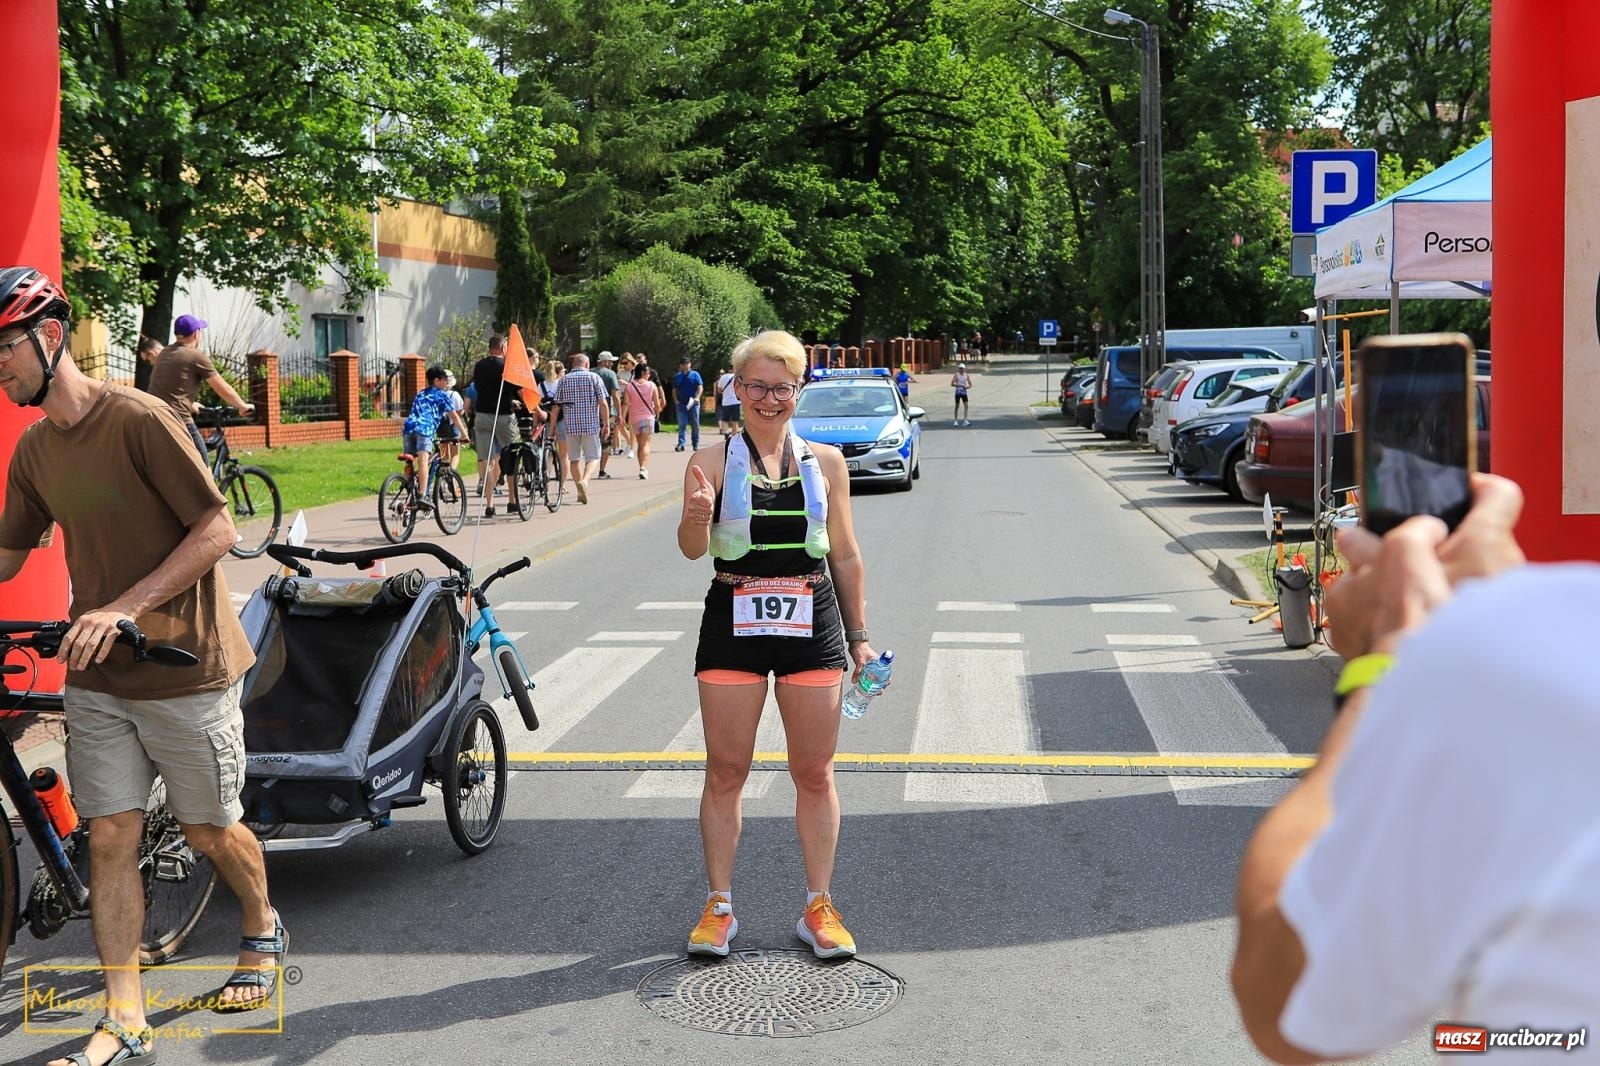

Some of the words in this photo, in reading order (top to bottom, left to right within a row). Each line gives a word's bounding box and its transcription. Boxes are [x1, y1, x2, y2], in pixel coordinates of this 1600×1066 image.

[1311, 160, 1358, 224] P
[1043, 322, 1054, 336] P
[811, 424, 869, 432] POLICJA
[752, 596, 797, 620] 197
[373, 768, 402, 790] Qeridoo
